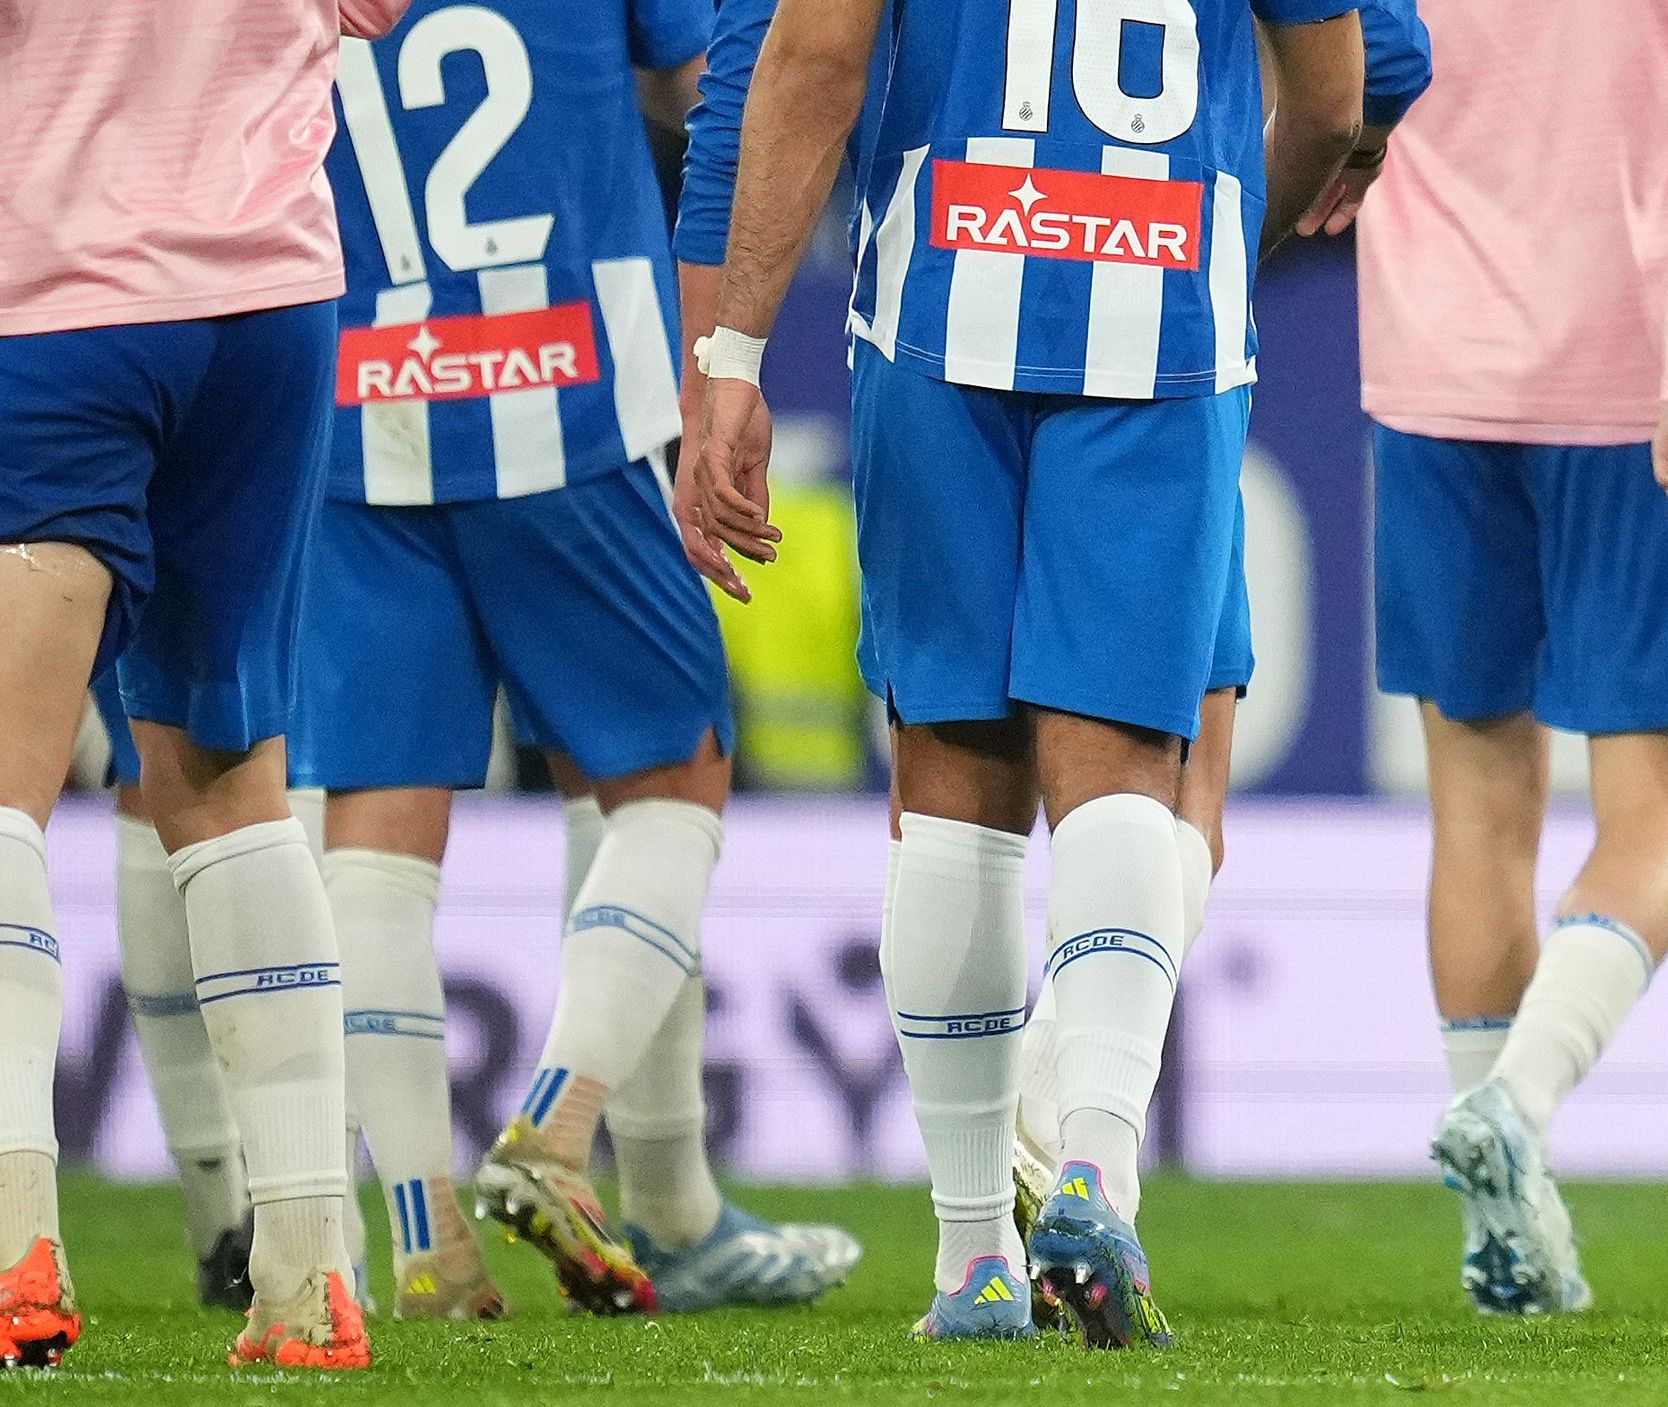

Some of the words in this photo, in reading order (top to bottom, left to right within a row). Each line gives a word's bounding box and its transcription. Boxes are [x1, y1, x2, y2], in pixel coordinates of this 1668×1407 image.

[335, 4, 555, 286] 12
[946, 203, 1189, 262] RASTAR
[357, 342, 579, 399] RASTAR
[1062, 935, 1125, 960] RCDE
[946, 1017, 1011, 1034] RCDE
